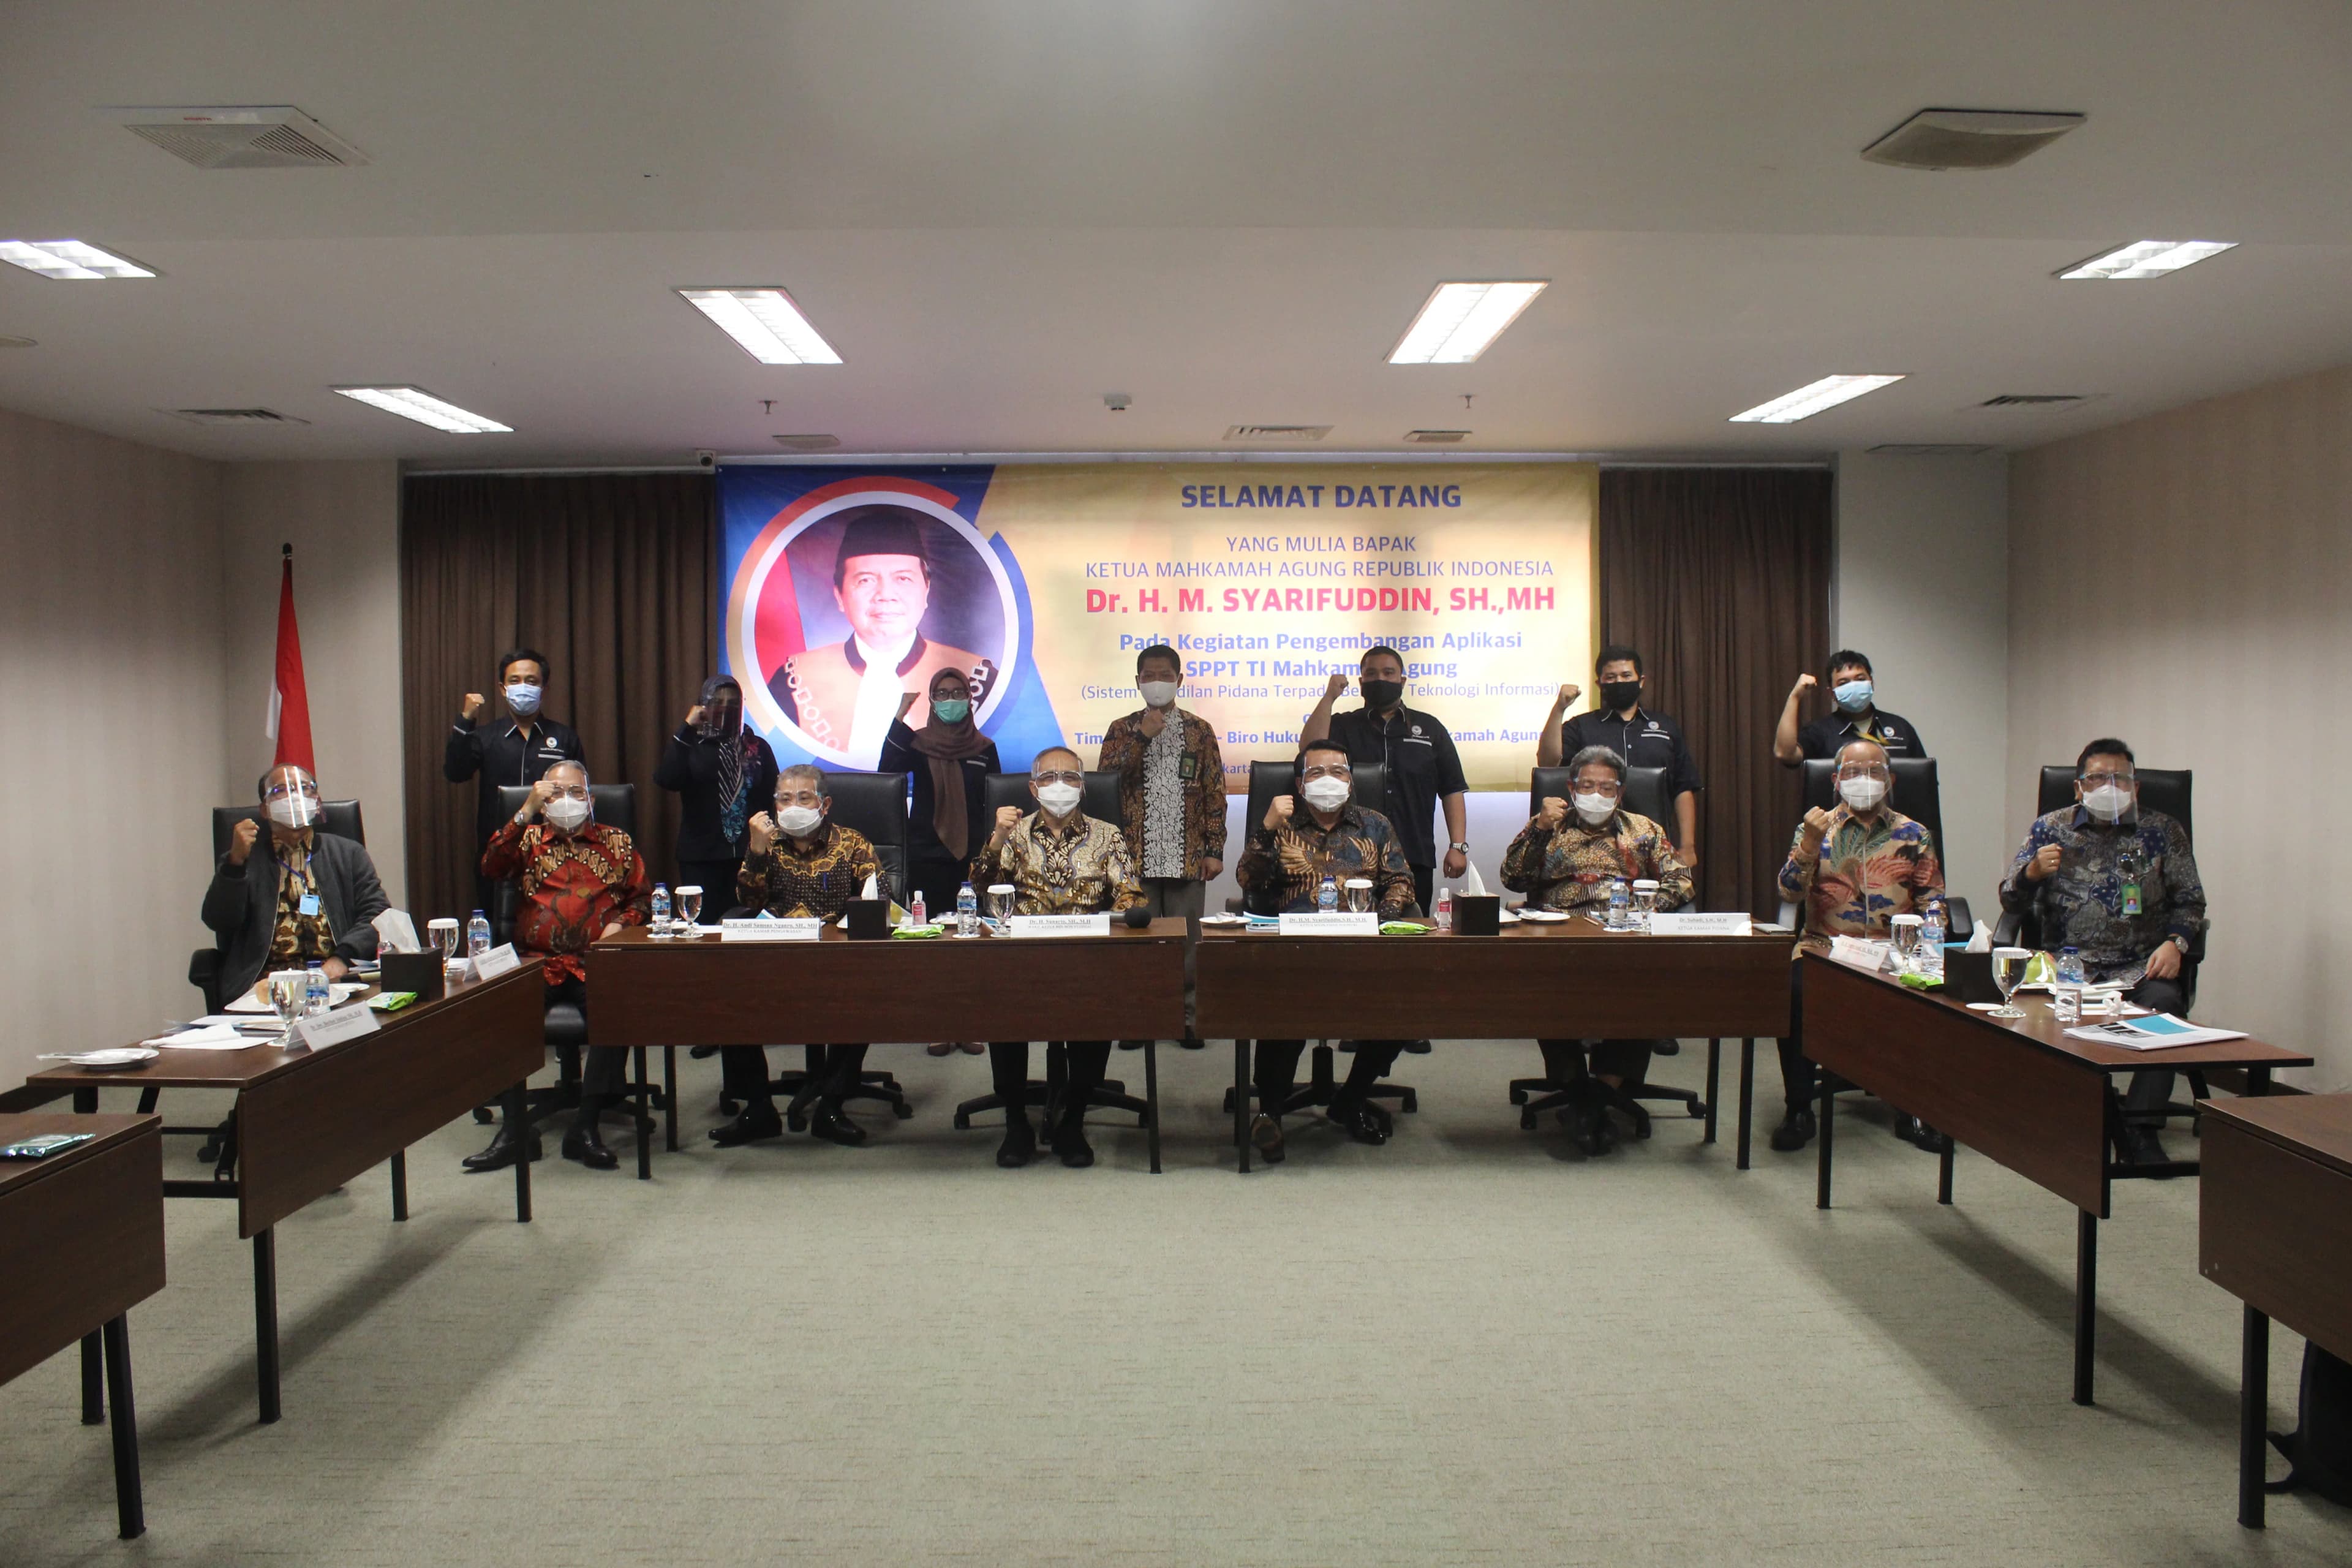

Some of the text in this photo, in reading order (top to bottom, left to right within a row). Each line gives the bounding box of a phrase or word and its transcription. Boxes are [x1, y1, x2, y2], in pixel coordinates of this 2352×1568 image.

[1182, 485, 1462, 508] SELAMAT DATANG
[1226, 537, 1416, 552] YANG MULIA BAPAK
[1087, 560, 1554, 578] KETUA MAHKAMAH AGUNG REPUBLIK INDONESIA
[1087, 589, 1128, 613] Dr.
[1139, 588, 1168, 613] H.
[1178, 588, 1213, 613] M.
[1223, 587, 1439, 616] SYARIFUDDIN,
[1120, 631, 1522, 653] Pada Kegiatan Pengembangan Aplikasi
[1186, 660, 1240, 677] SPPT
[1246, 660, 1265, 676] TI
[1273, 659, 1361, 677] Mahkam
[1082, 685, 1137, 699] (Sistem
[1176, 685, 1213, 698] dilan
[1218, 684, 1268, 698] Pidana
[1274, 684, 1325, 699] Terpad
[1409, 684, 1480, 698] Teknologi
[1485, 682, 1560, 696] Informasi)
[1227, 731, 1259, 744] Biro
[1264, 731, 1300, 744] Huku
